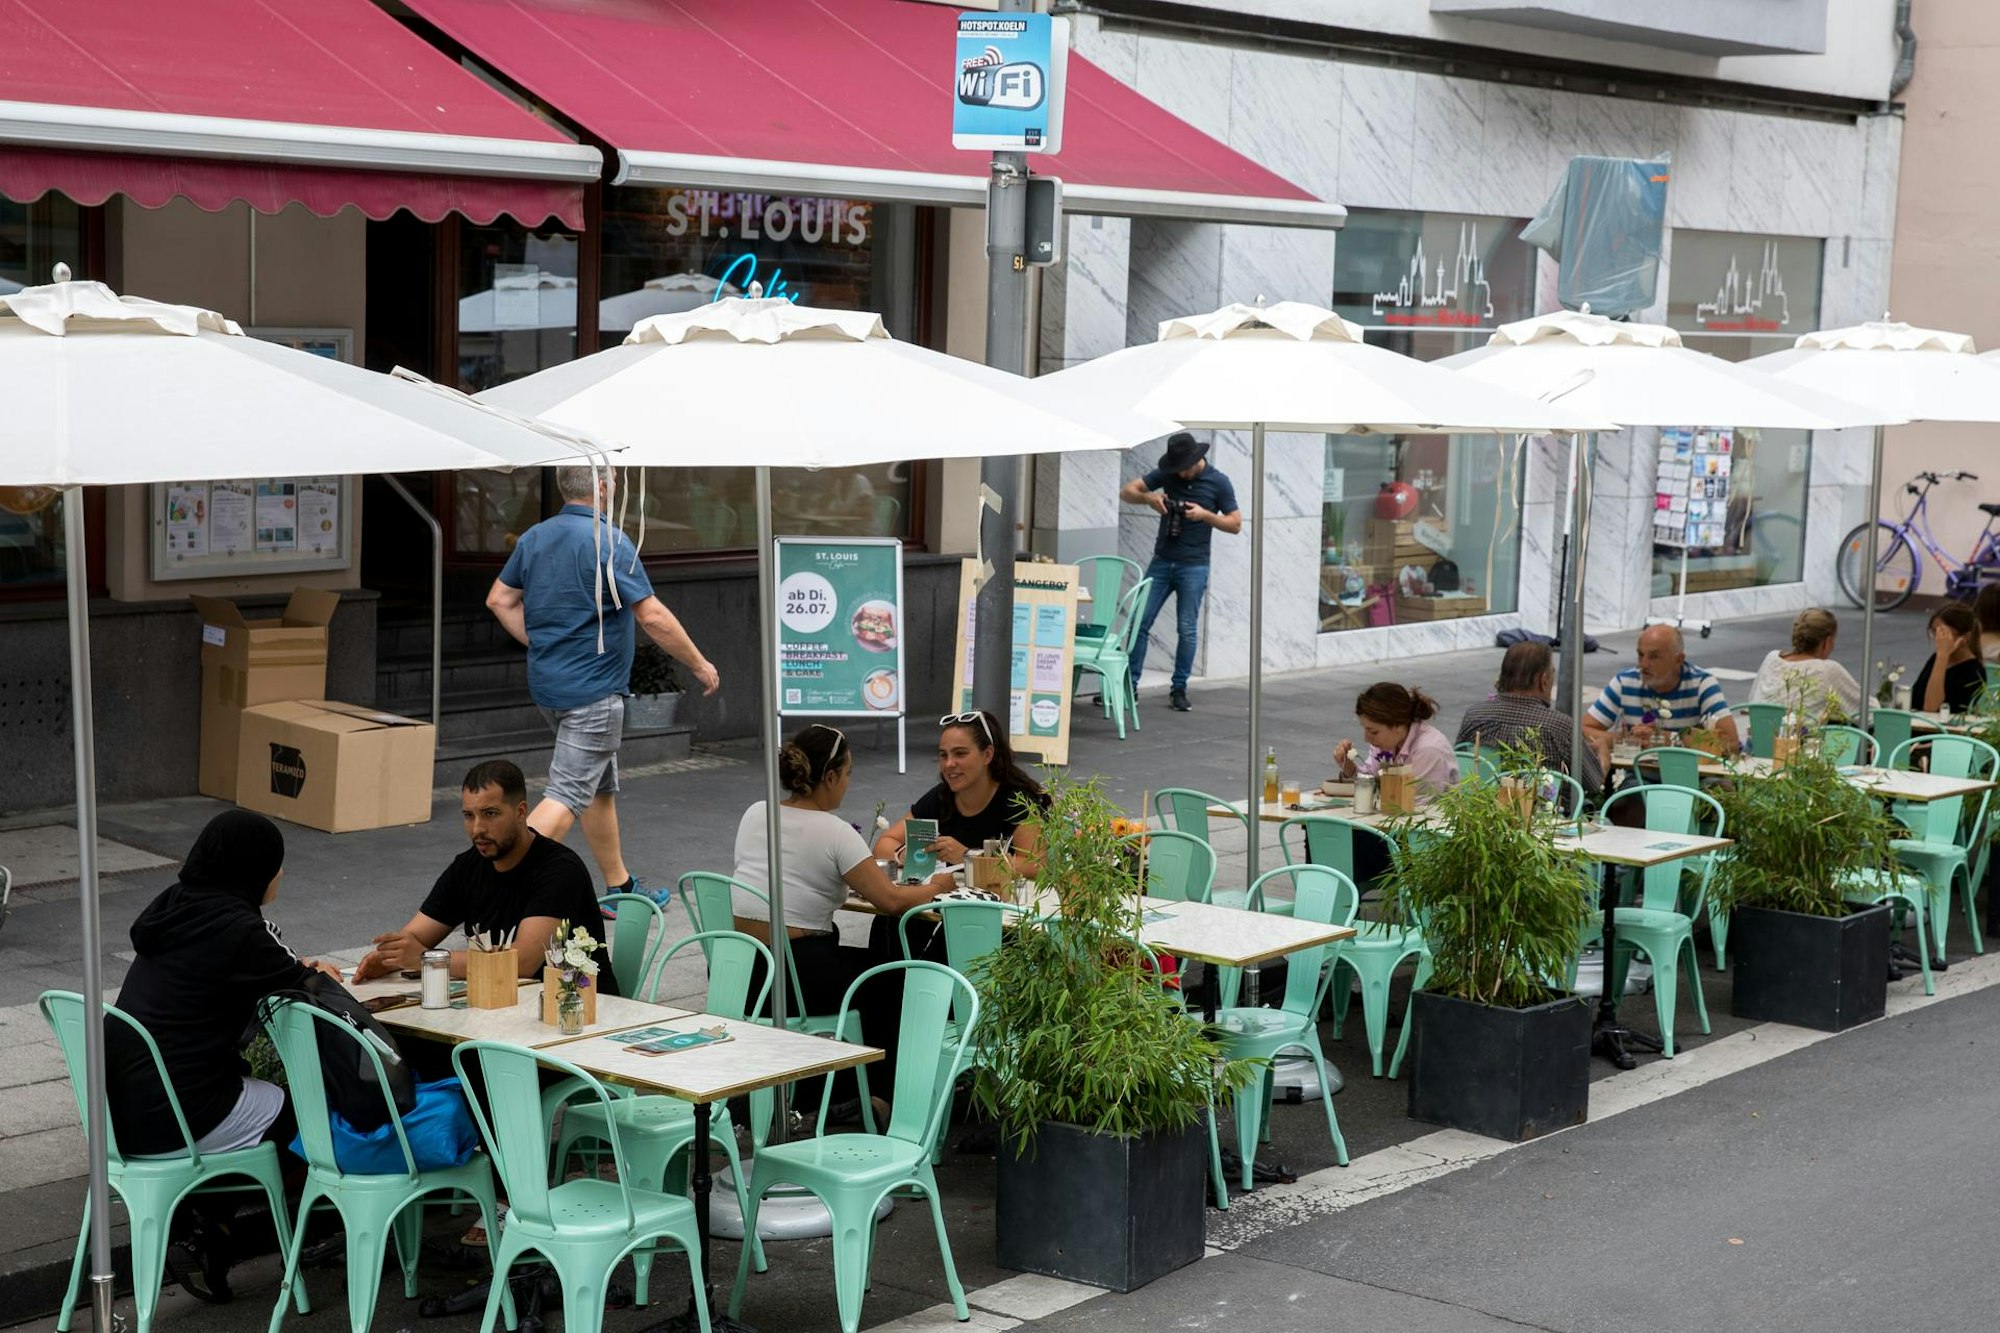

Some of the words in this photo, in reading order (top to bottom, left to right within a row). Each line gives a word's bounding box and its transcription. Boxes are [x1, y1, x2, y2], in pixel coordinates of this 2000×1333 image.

[960, 20, 1026, 31] HOTSPOT.KOELN
[961, 57, 985, 69] FREE
[666, 194, 729, 239] ST.
[740, 201, 867, 246] LOUIS
[815, 552, 829, 560] ST.
[830, 552, 859, 561] LOUIS
[1014, 578, 1070, 590] SANGEBOT
[788, 589, 806, 600] ab
[809, 589, 827, 600] Di.
[786, 603, 830, 614] 26.07.
[785, 659, 821, 668] LUNCH
[795, 669, 822, 678] CAKE
